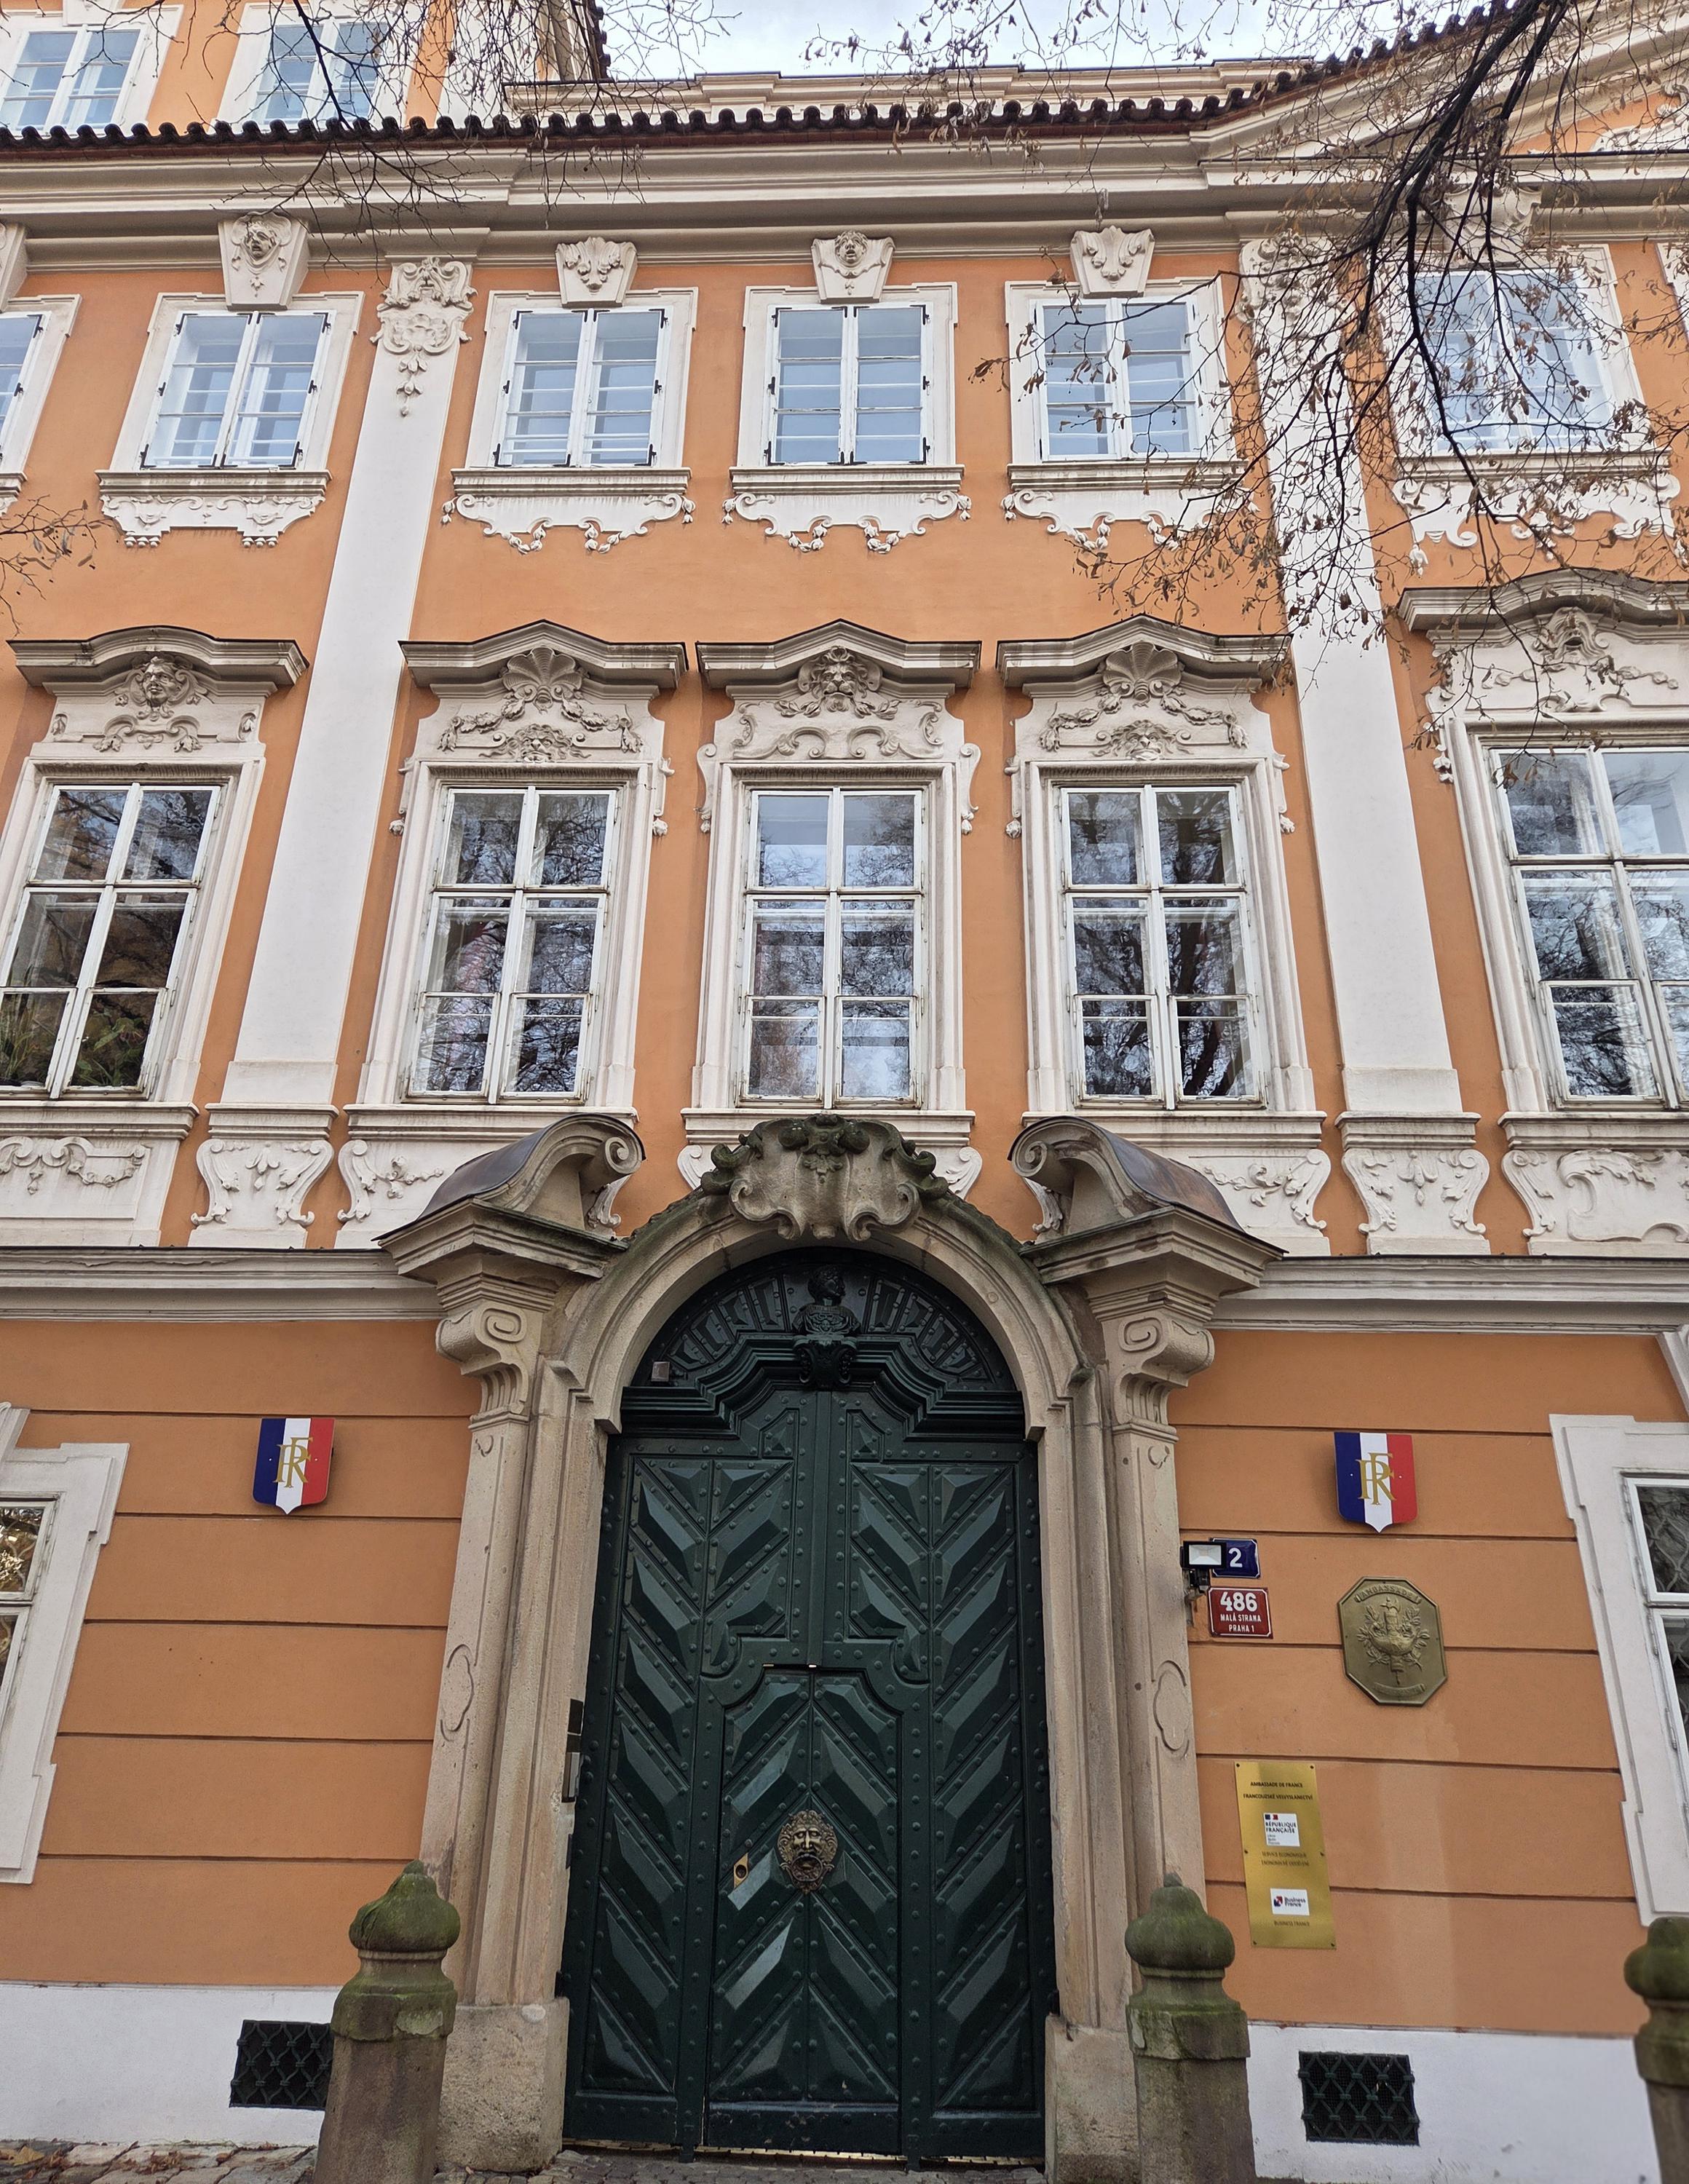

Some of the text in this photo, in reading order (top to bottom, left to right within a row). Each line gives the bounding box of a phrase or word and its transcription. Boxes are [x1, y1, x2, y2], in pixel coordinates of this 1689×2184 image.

[1228, 1547, 1243, 1567] 2
[1220, 1591, 1257, 1612] 486
[1220, 1613, 1261, 1622] MALÁ STRANA
[1228, 1624, 1250, 1632] PRAHA
